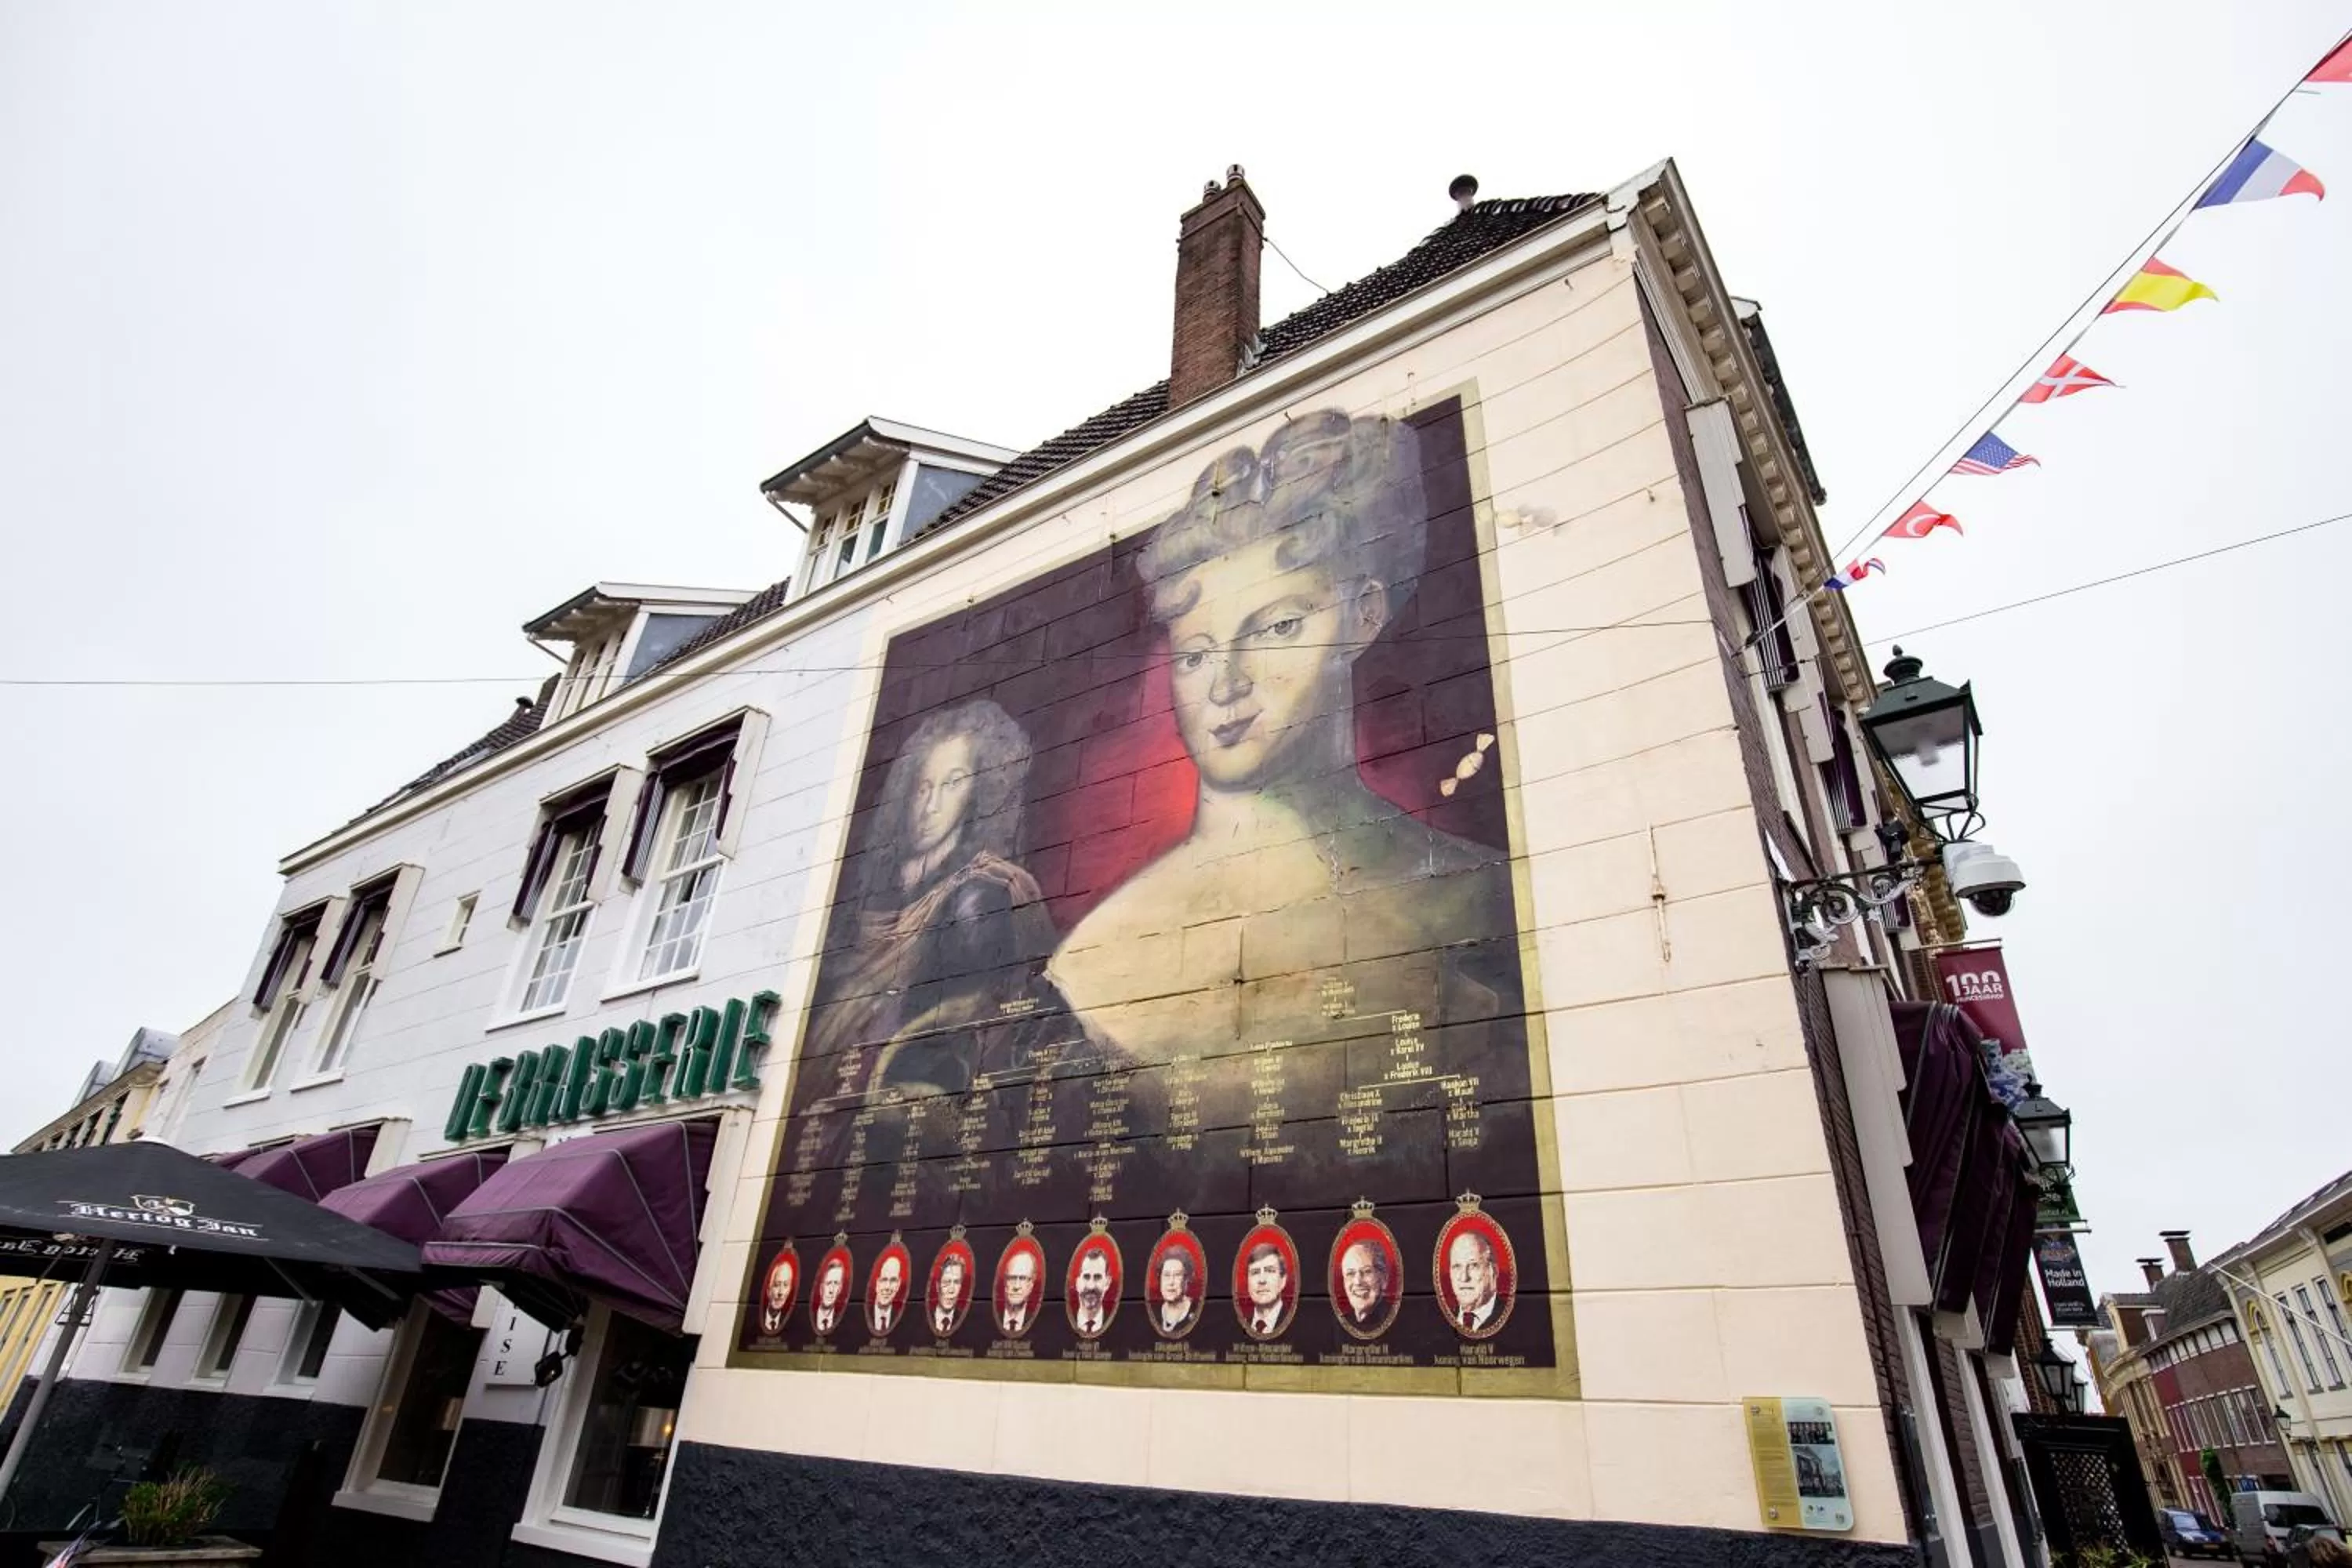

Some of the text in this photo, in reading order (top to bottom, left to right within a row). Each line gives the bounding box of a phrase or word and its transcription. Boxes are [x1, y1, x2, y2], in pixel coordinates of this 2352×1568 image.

[1962, 983, 2003, 995] JAAR
[497, 989, 781, 1133] BRASSERIE
[69, 1203, 258, 1238] Hertog Jan
[2047, 1277, 2085, 1287] Holland
